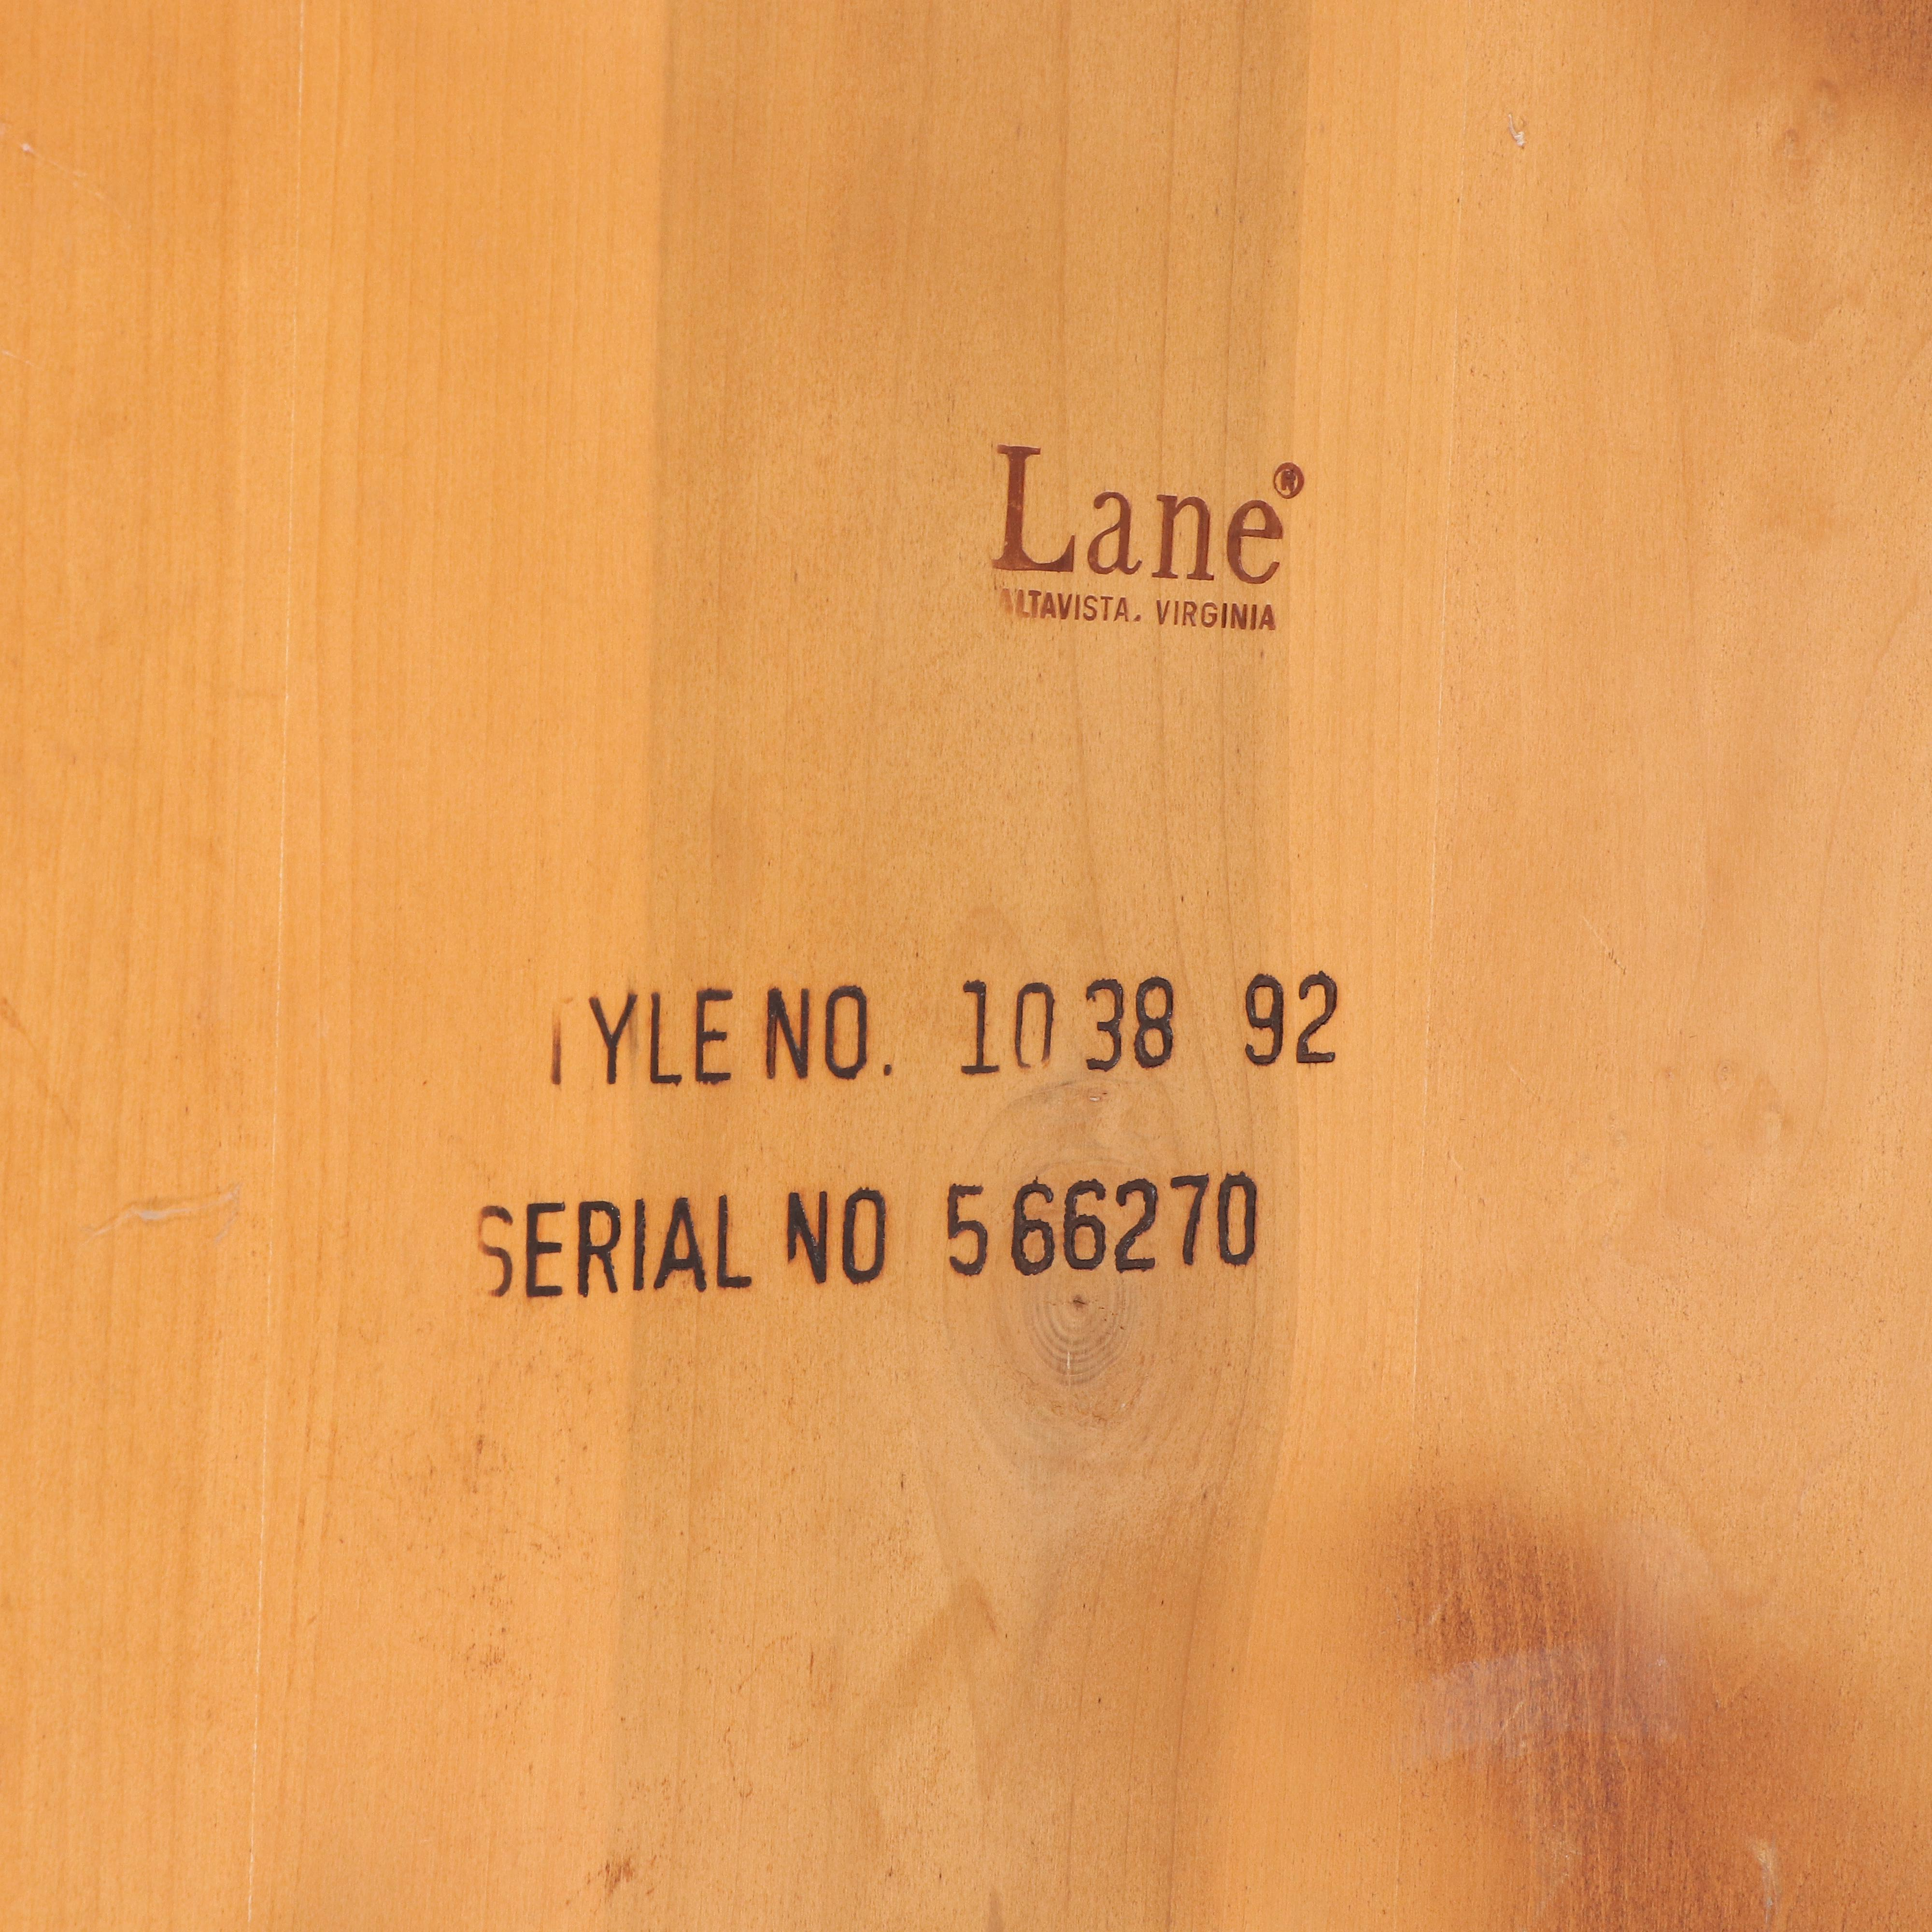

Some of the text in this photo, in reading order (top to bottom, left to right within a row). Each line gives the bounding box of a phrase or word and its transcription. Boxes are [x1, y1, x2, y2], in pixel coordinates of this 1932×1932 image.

[1156, 599, 1276, 631] VIRGINIA
[766, 985, 892, 1080] NO.
[1245, 970, 1338, 1067] 92
[477, 1193, 753, 1298] SERIAL
[787, 1187, 886, 1286] NO
